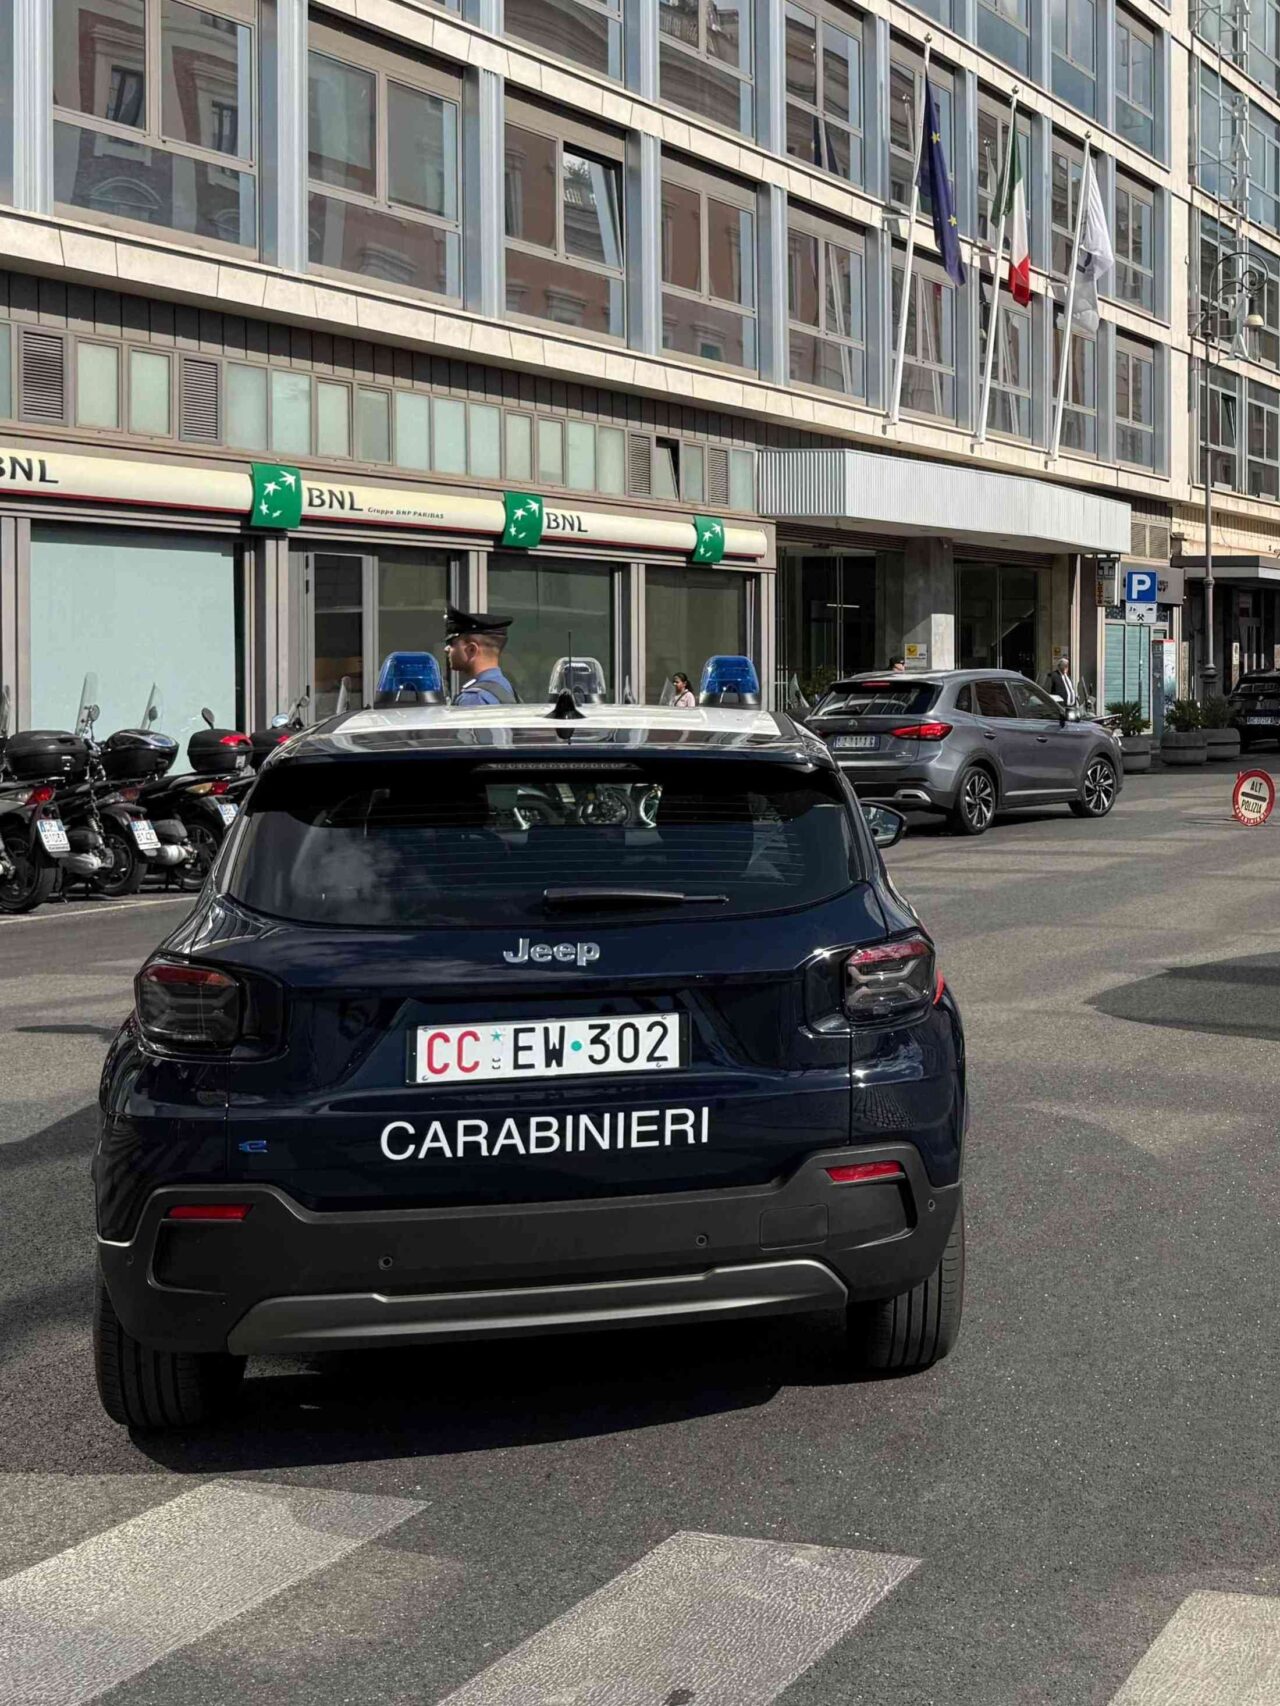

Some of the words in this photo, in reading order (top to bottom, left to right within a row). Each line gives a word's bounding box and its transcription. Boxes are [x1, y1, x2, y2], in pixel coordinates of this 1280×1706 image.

[0, 456, 59, 485] NL
[307, 487, 363, 512] BNL
[546, 512, 589, 533] BNL
[1131, 573, 1152, 600] P
[1250, 780, 1263, 793] ALT
[503, 937, 601, 967] Jeep
[426, 1030, 481, 1075] CC
[513, 1025, 566, 1070] EW
[587, 1020, 669, 1065] 302
[380, 1106, 710, 1161] CARABINIERI
